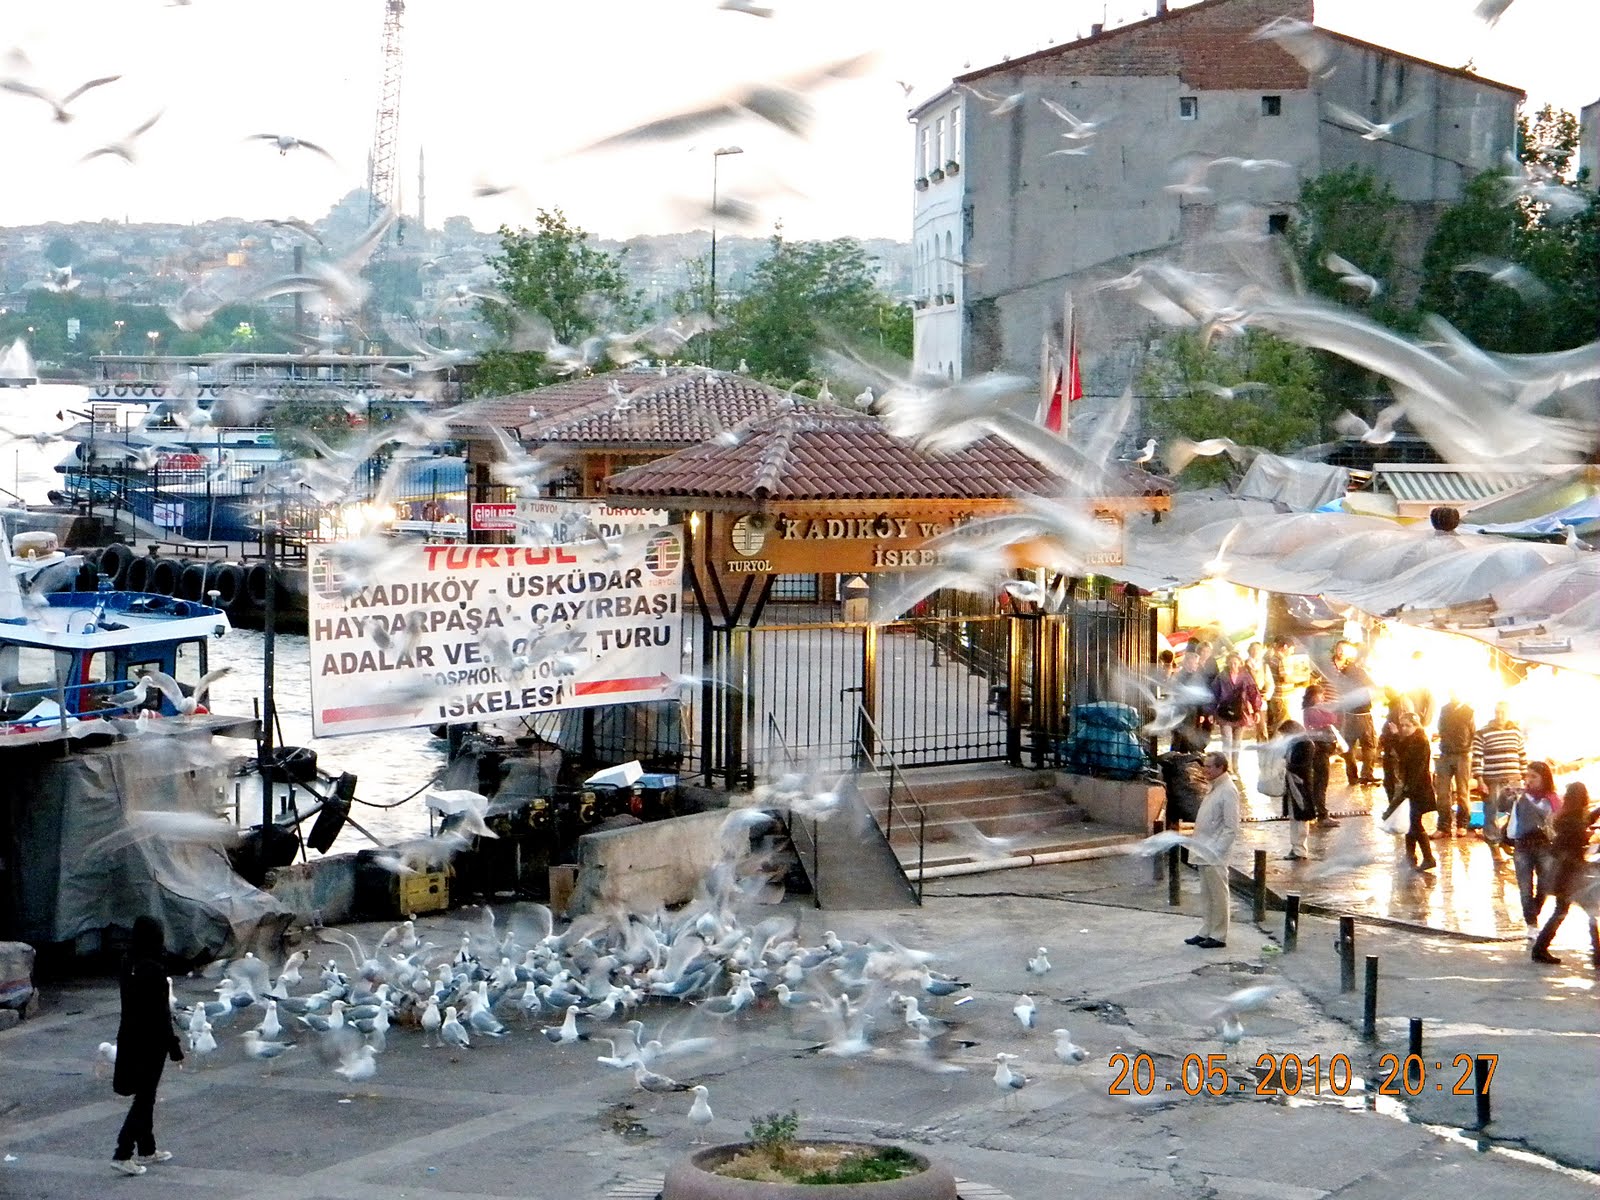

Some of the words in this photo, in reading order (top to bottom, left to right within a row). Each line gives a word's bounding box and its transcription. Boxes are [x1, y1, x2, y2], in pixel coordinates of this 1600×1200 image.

[728, 559, 773, 573] TURYOL
[350, 576, 479, 609] KADIKÖY
[507, 567, 643, 598] ÜSKÜDAR
[530, 593, 677, 630] ÇAYIRBAŞI
[321, 645, 435, 677] ADALAR
[443, 641, 483, 666] VE
[597, 625, 671, 652] TURU
